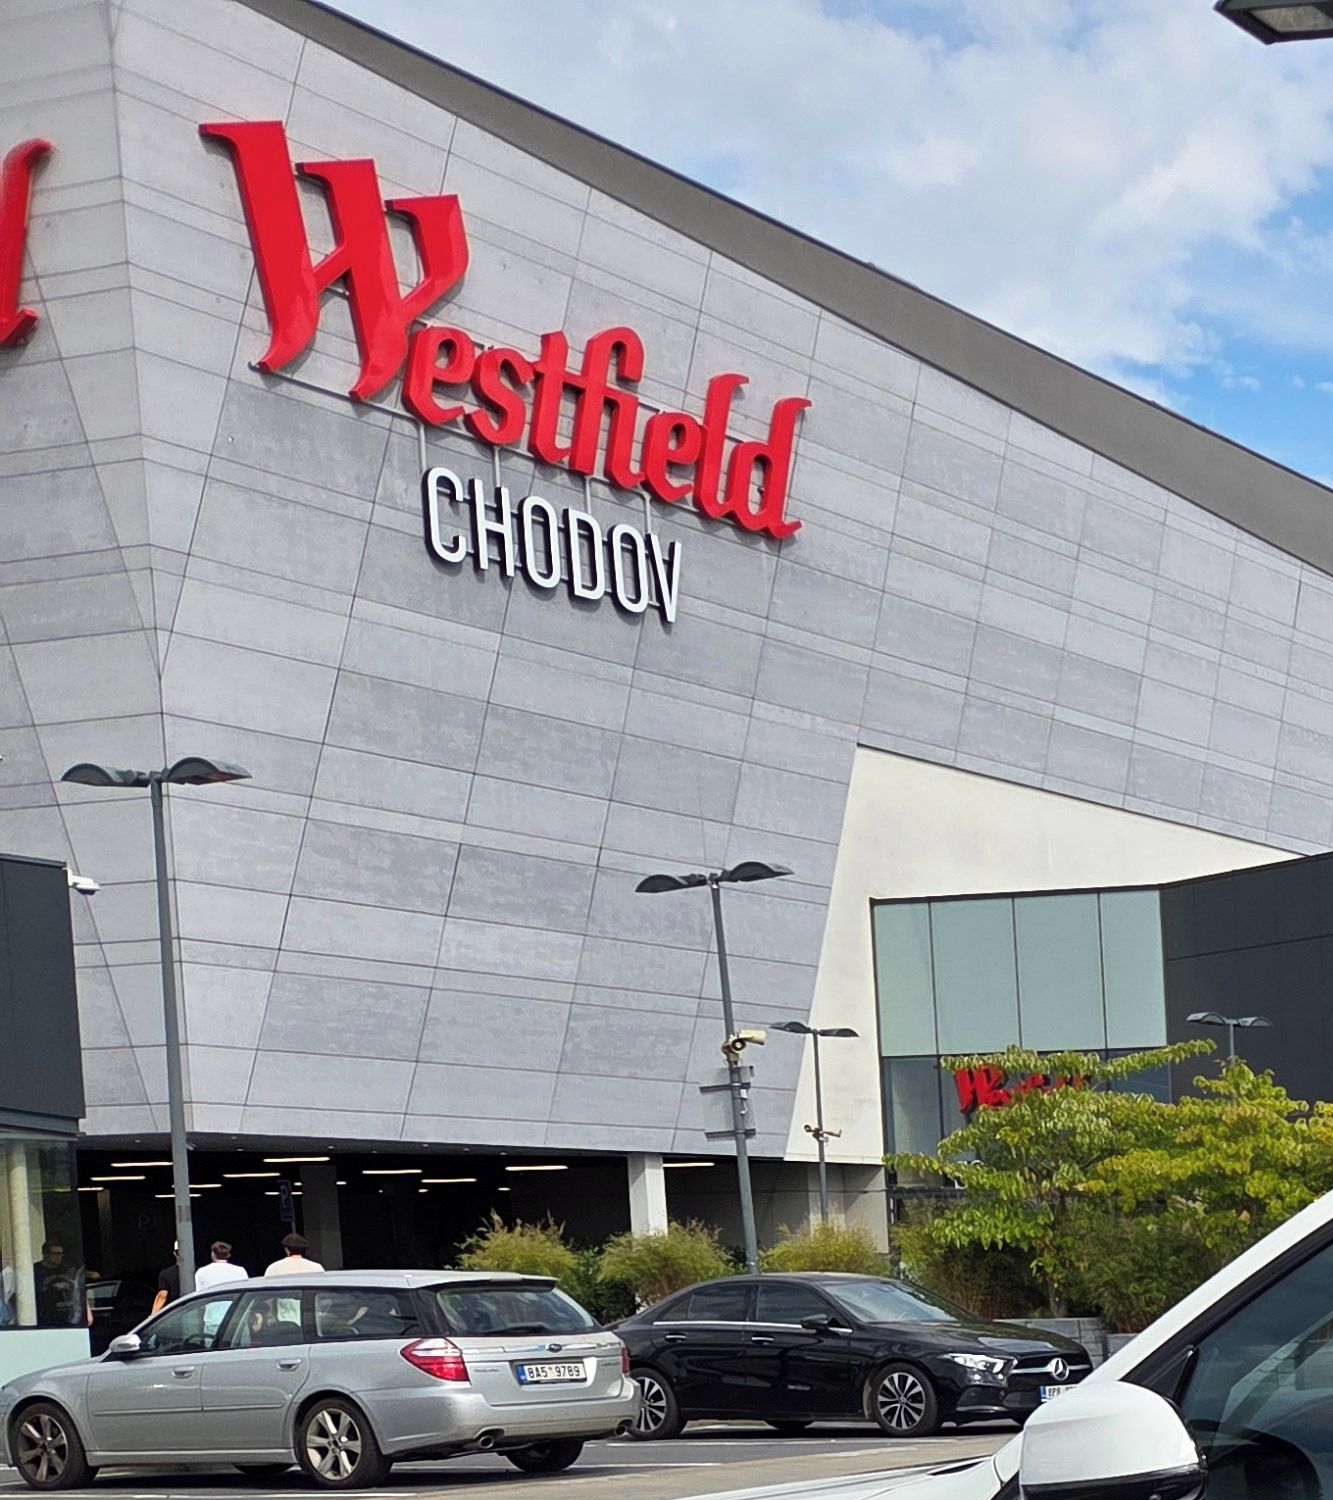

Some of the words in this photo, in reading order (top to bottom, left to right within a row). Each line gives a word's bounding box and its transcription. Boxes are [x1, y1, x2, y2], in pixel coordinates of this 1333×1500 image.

[199, 119, 812, 540] Westfield
[424, 466, 682, 623] CHODOV
[527, 1366, 549, 1379] 8A5
[555, 1364, 581, 1378] 9789
